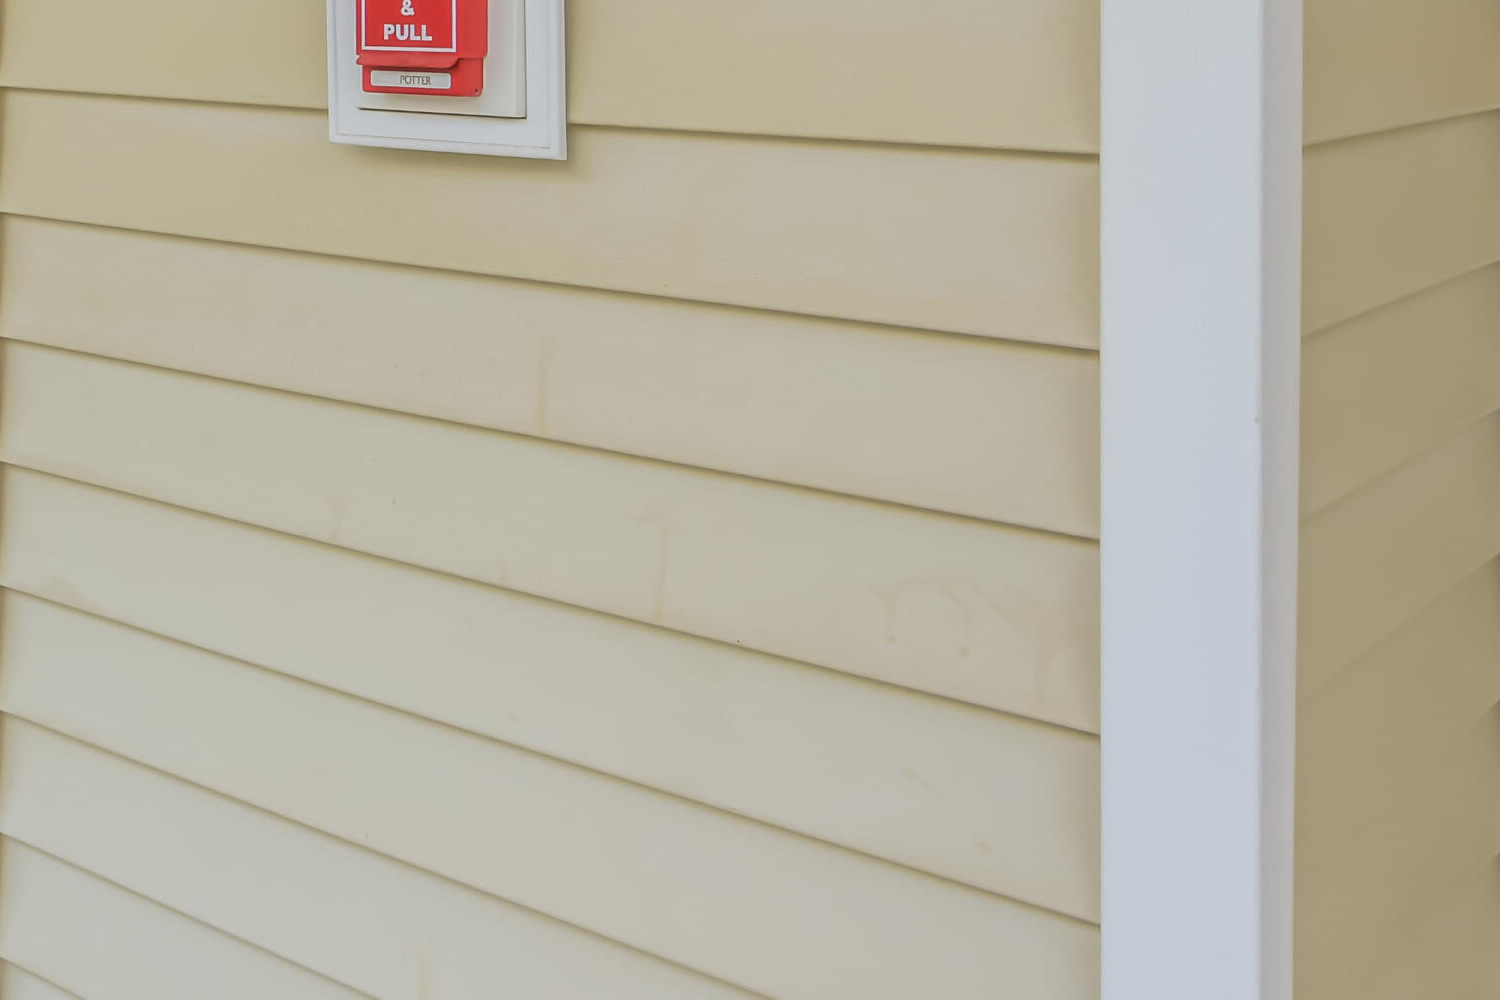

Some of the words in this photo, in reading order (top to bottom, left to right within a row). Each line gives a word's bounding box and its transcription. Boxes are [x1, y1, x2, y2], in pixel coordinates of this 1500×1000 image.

[400, 0, 415, 16] &
[383, 23, 433, 41] PULL
[400, 75, 431, 86] POTTER
